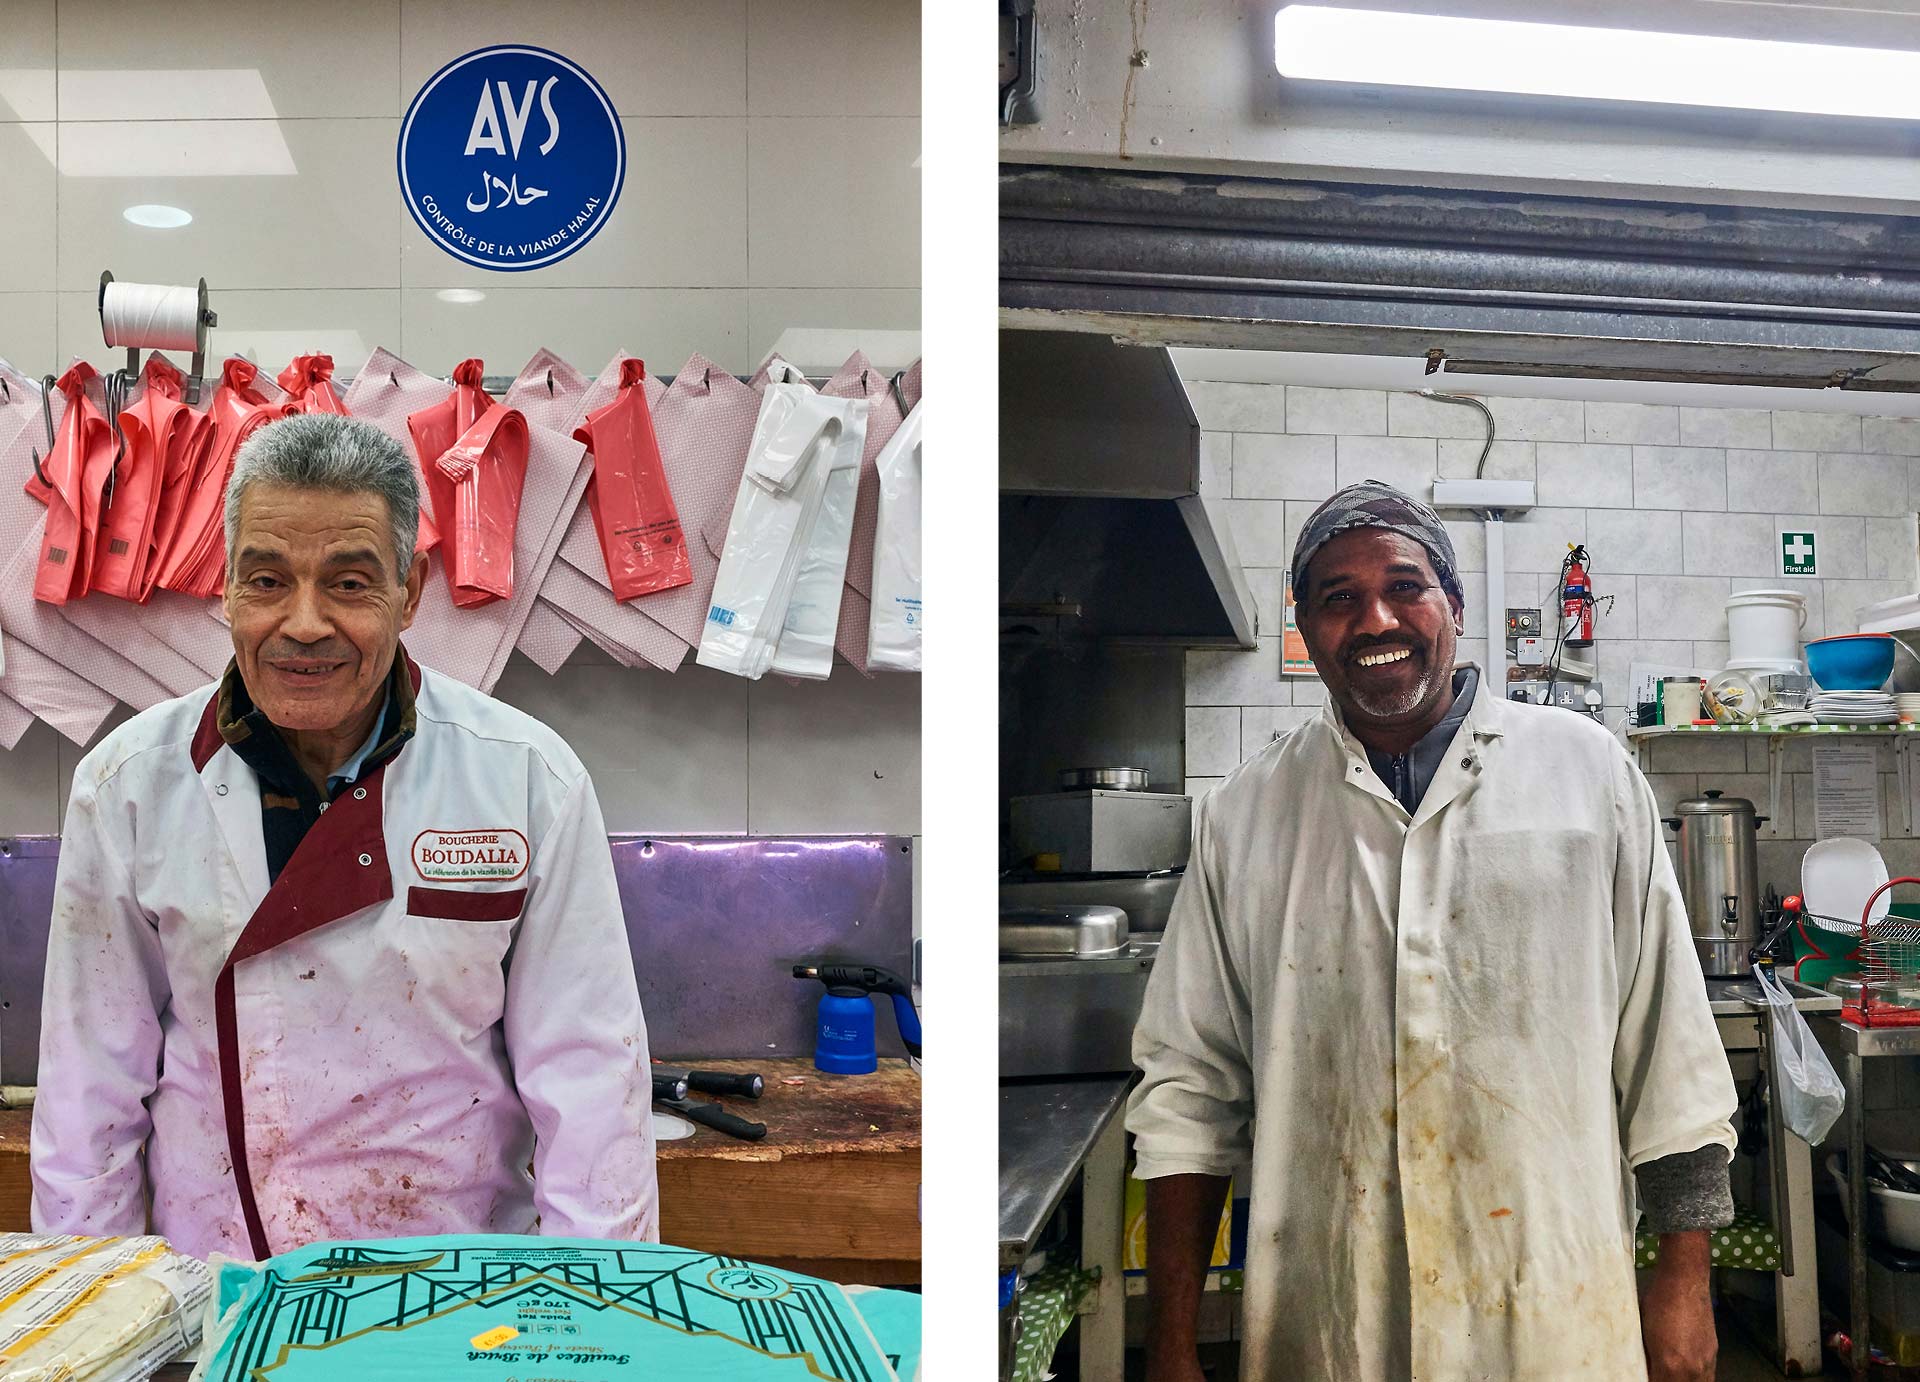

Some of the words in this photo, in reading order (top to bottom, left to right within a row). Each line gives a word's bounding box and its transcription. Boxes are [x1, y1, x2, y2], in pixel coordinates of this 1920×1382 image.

[464, 75, 560, 161] AVS
[466, 170, 549, 213] حلال
[422, 195, 475, 248] CONTRÔLE
[478, 241, 495, 255] DE
[499, 244, 515, 257] LA
[519, 229, 569, 256] VIANDE
[567, 197, 601, 233] HALAL
[438, 835, 499, 846] BOUCHERIE
[421, 848, 520, 865] BOUDALIA
[461, 867, 469, 876] de
[470, 867, 476, 876] la
[477, 867, 498, 876] viande
[546, 1344, 560, 1353] of
[564, 1345, 605, 1353] Sheets
[466, 1351, 521, 1363] Brick
[527, 1352, 549, 1364] de
[556, 1353, 631, 1365] Feuilles
